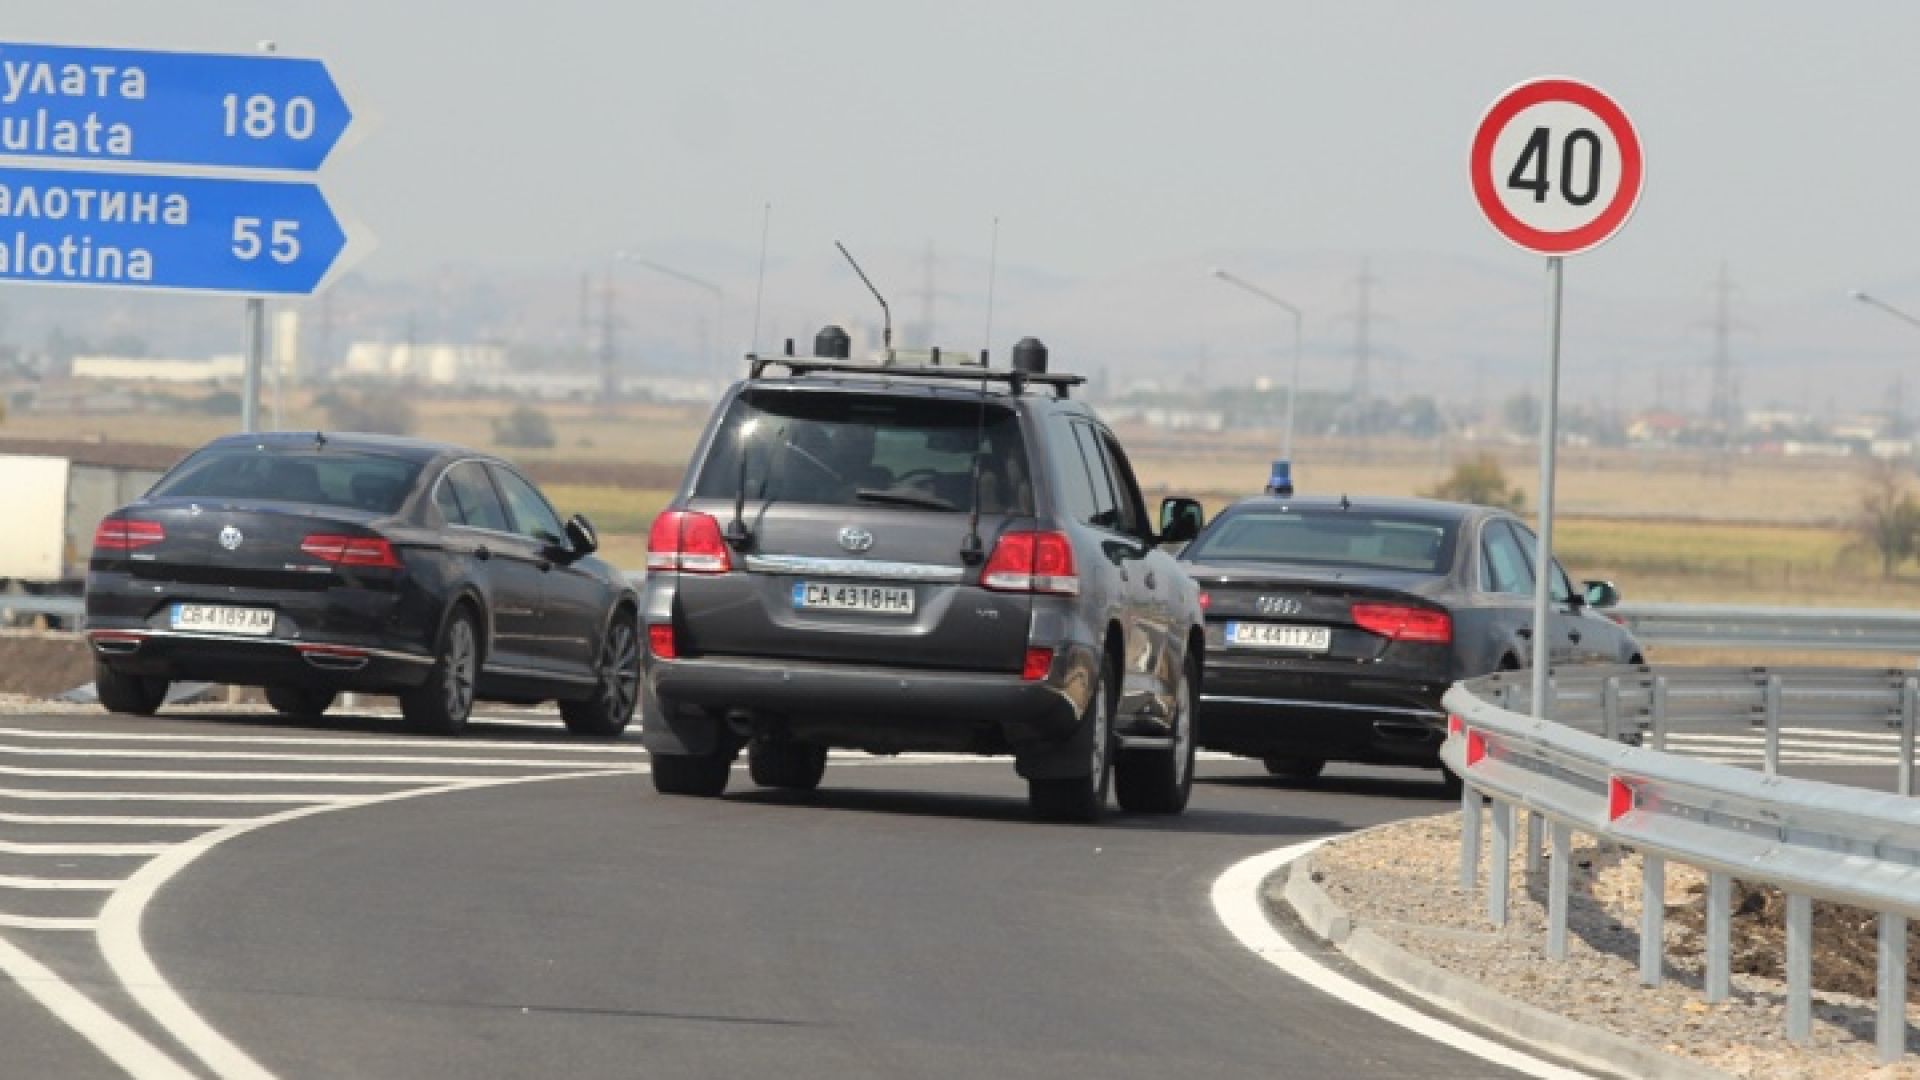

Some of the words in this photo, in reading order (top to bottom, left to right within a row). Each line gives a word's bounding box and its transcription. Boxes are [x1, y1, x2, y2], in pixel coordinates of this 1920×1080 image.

[2, 107, 132, 155] ulata
[222, 93, 315, 140] 180
[1507, 126, 1602, 206] 40
[231, 215, 300, 264] 55
